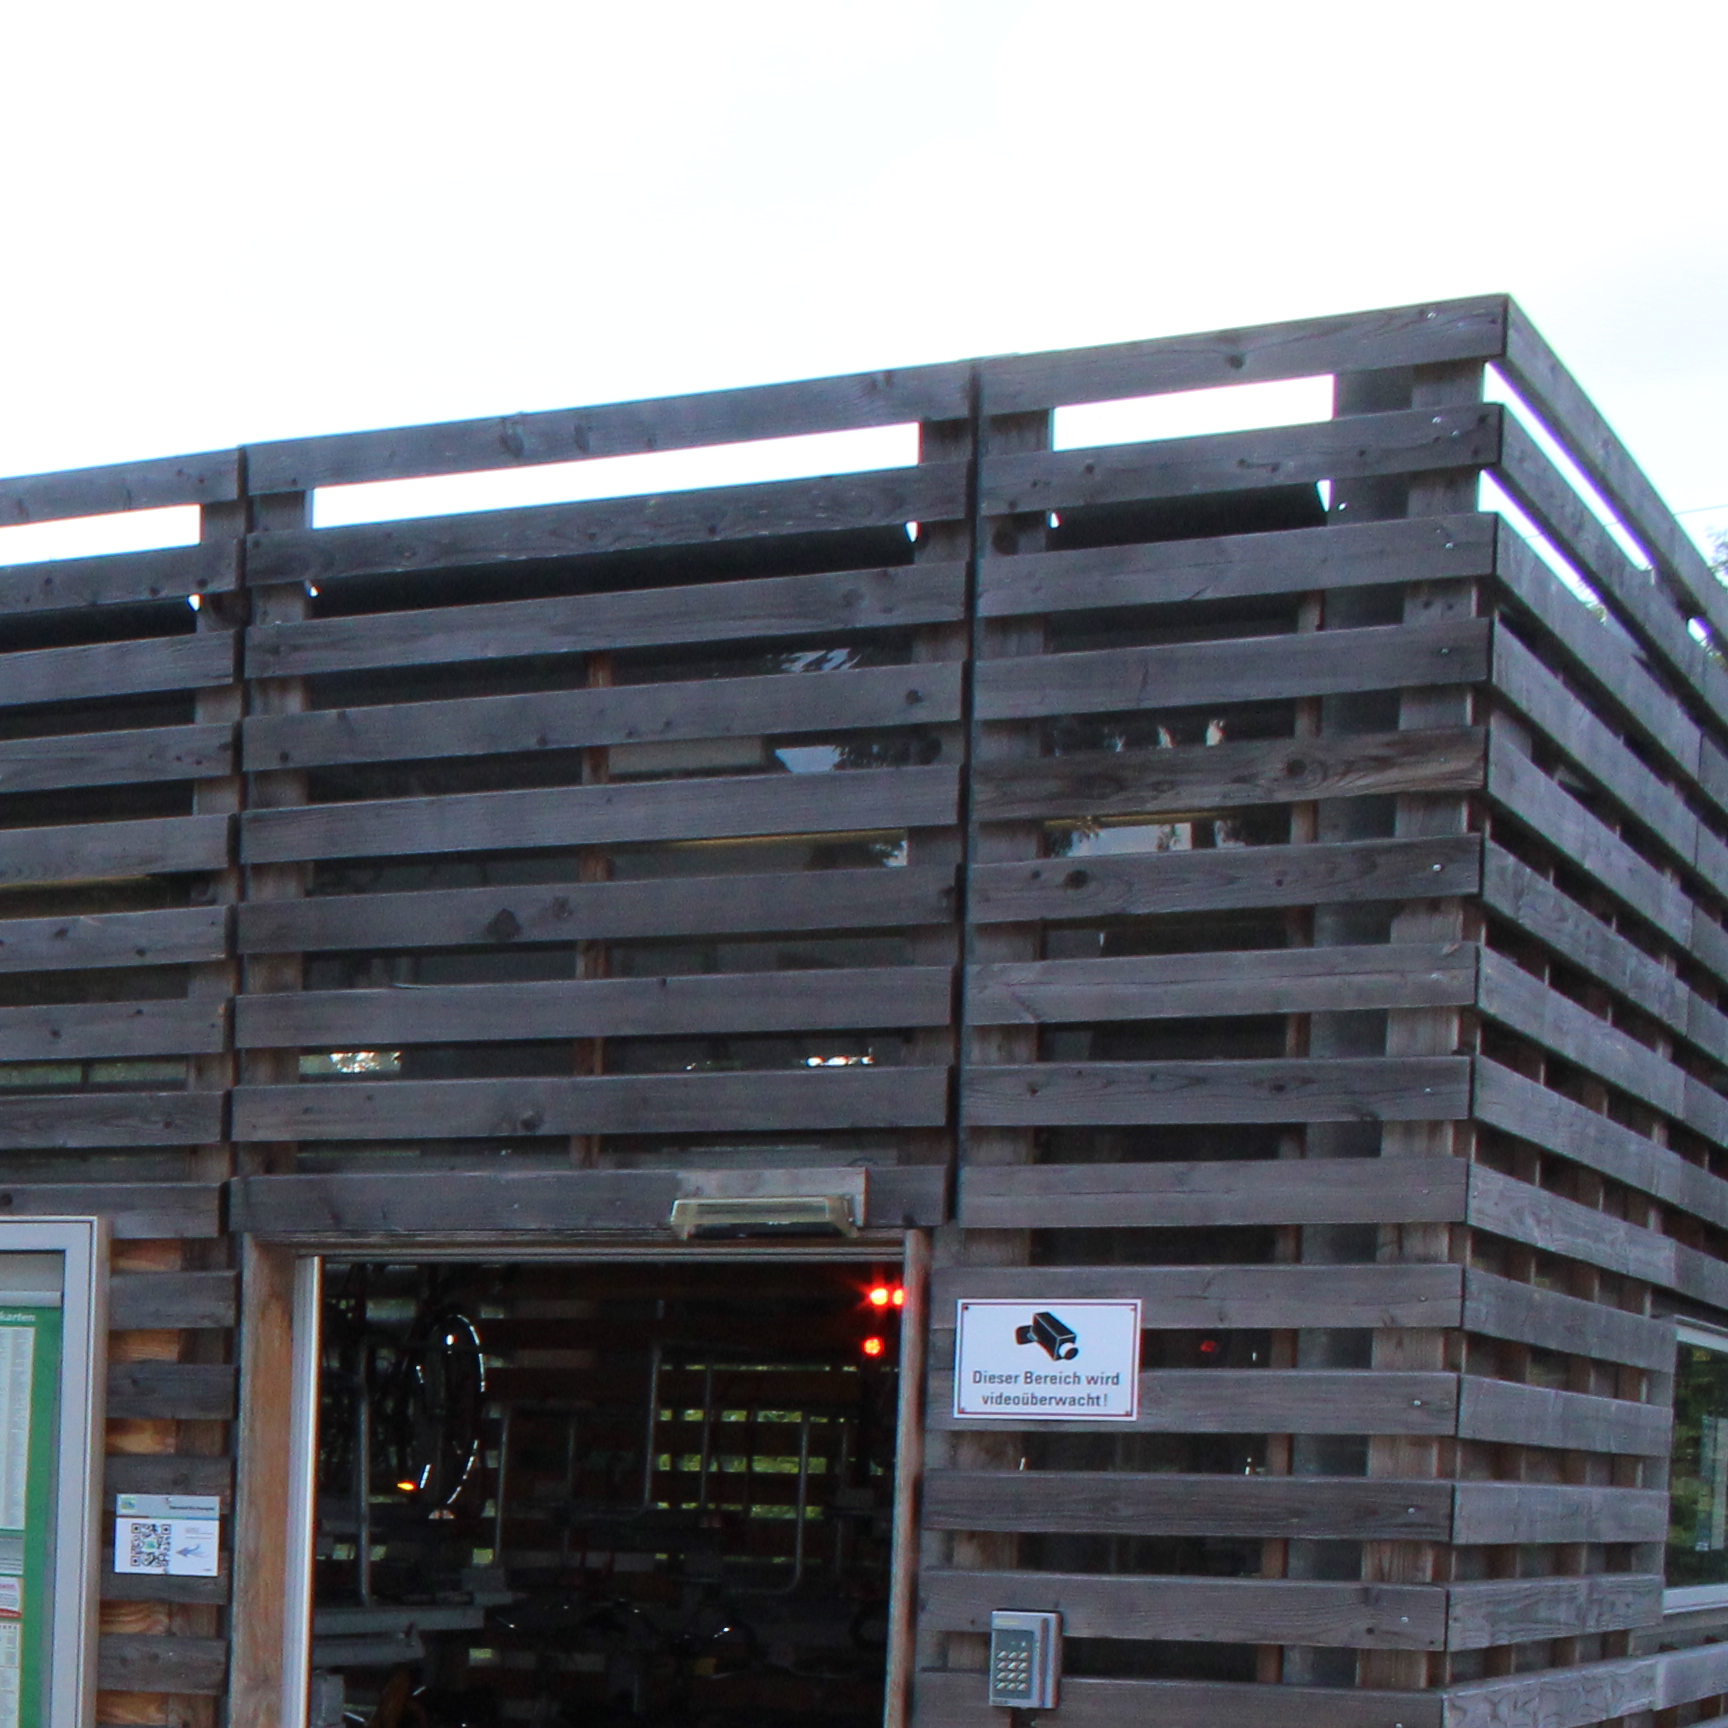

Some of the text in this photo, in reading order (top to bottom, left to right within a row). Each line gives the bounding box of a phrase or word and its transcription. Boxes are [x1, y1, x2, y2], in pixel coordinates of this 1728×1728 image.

[972, 1370, 1121, 1386] Dieser Bereich wird
[981, 1392, 1108, 1407] videoüberwacht!
